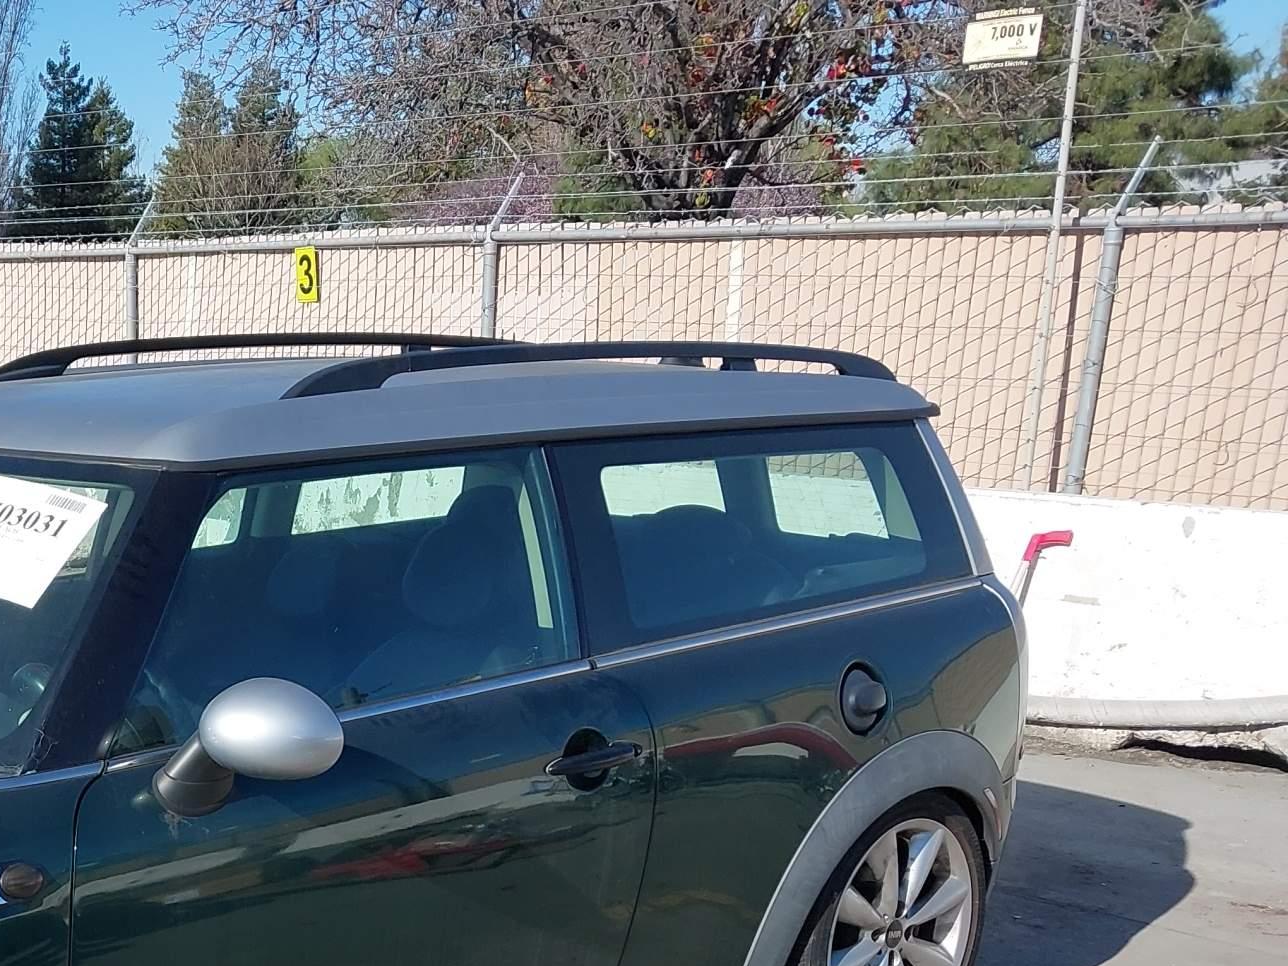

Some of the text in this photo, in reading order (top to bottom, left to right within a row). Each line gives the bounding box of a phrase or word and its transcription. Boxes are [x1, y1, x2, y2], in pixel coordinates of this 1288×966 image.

[991, 23, 1038, 41] 7,000 V
[299, 254, 314, 295] 3
